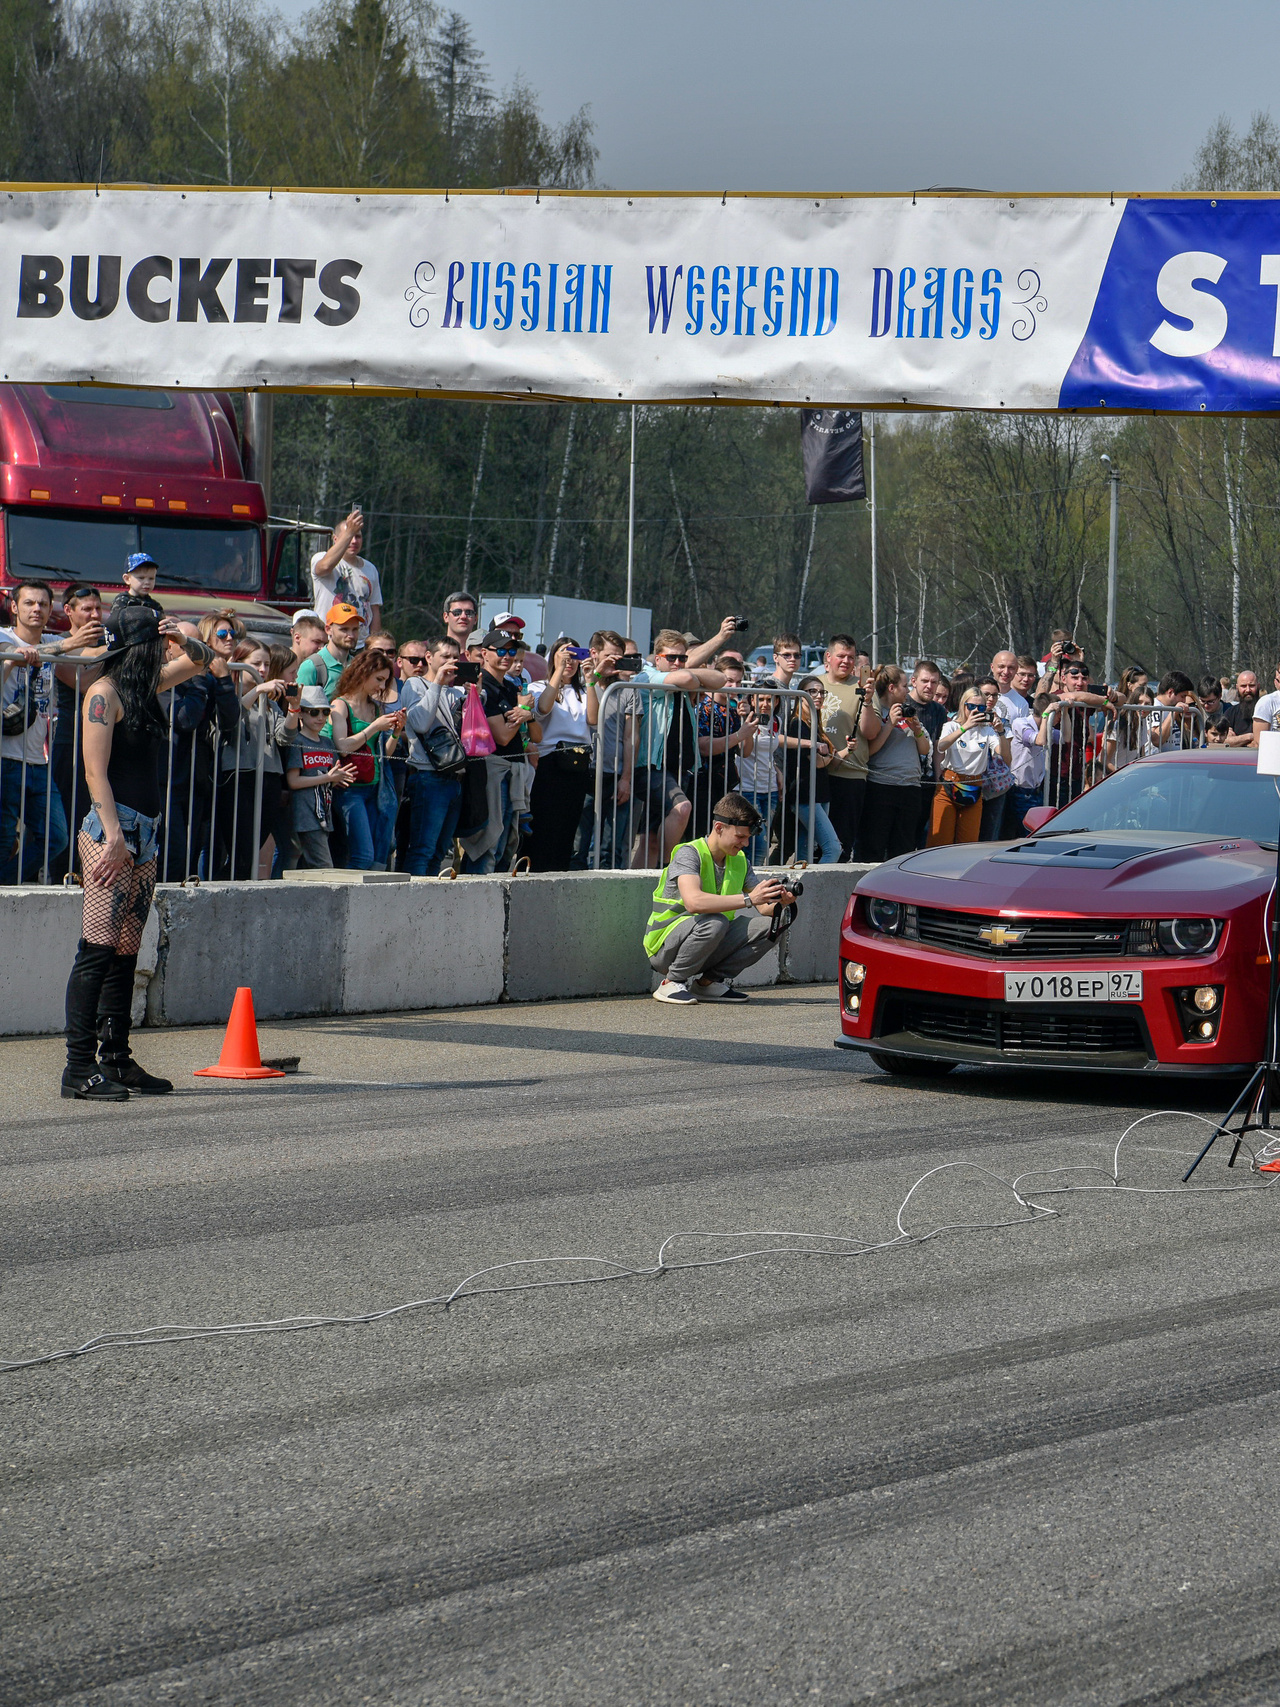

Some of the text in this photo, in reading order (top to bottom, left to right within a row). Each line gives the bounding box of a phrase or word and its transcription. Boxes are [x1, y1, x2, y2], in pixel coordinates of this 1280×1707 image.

[17, 254, 363, 327] BUCKETS
[441, 261, 1003, 341] RUSSIAN WEEKEND DRAGS
[1111, 974, 1133, 991] 97
